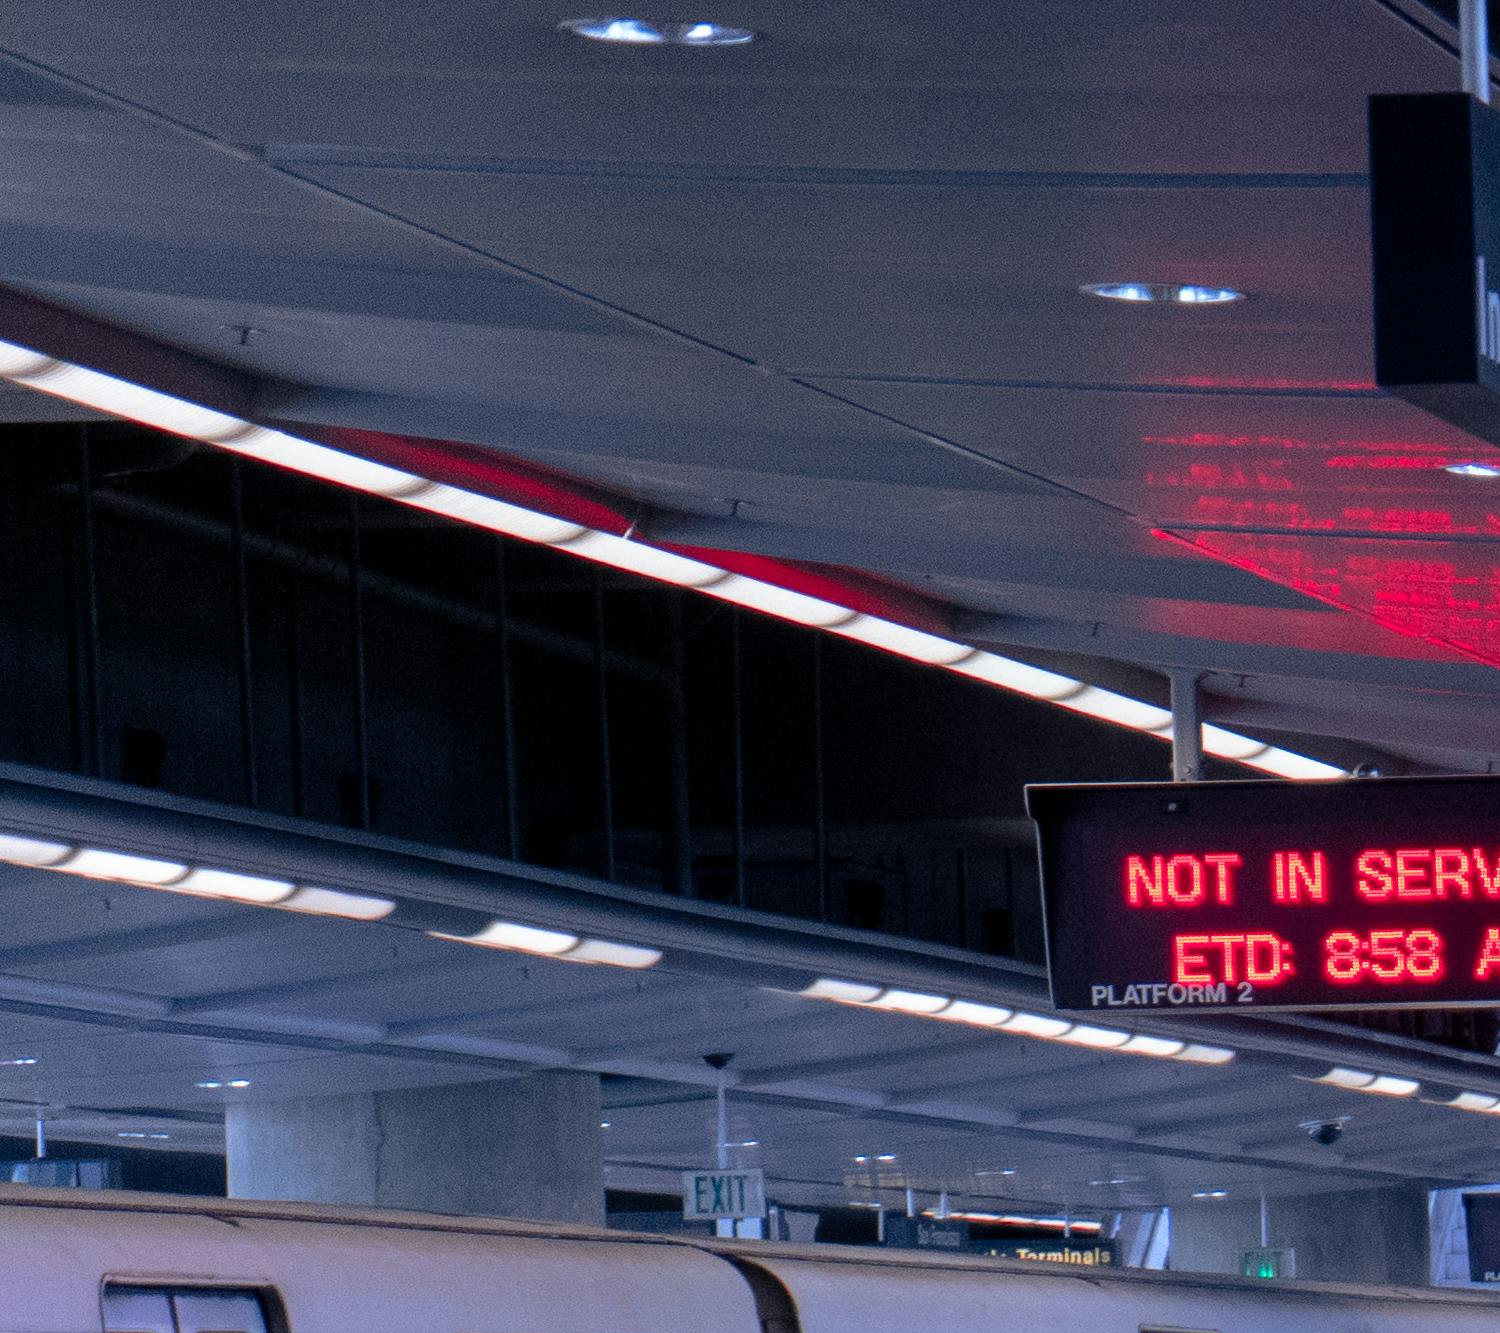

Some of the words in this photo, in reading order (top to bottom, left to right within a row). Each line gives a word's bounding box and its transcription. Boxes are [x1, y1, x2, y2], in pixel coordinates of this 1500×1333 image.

[1126, 854, 1239, 908] NOT
[1275, 850, 1326, 902] IN
[1173, 932, 1294, 986] ETD:
[1325, 929, 1441, 982] 8:58
[1091, 981, 1228, 1007] PLATFORM
[1237, 980, 1254, 1003] 2
[695, 1175, 748, 1213] EXIT
